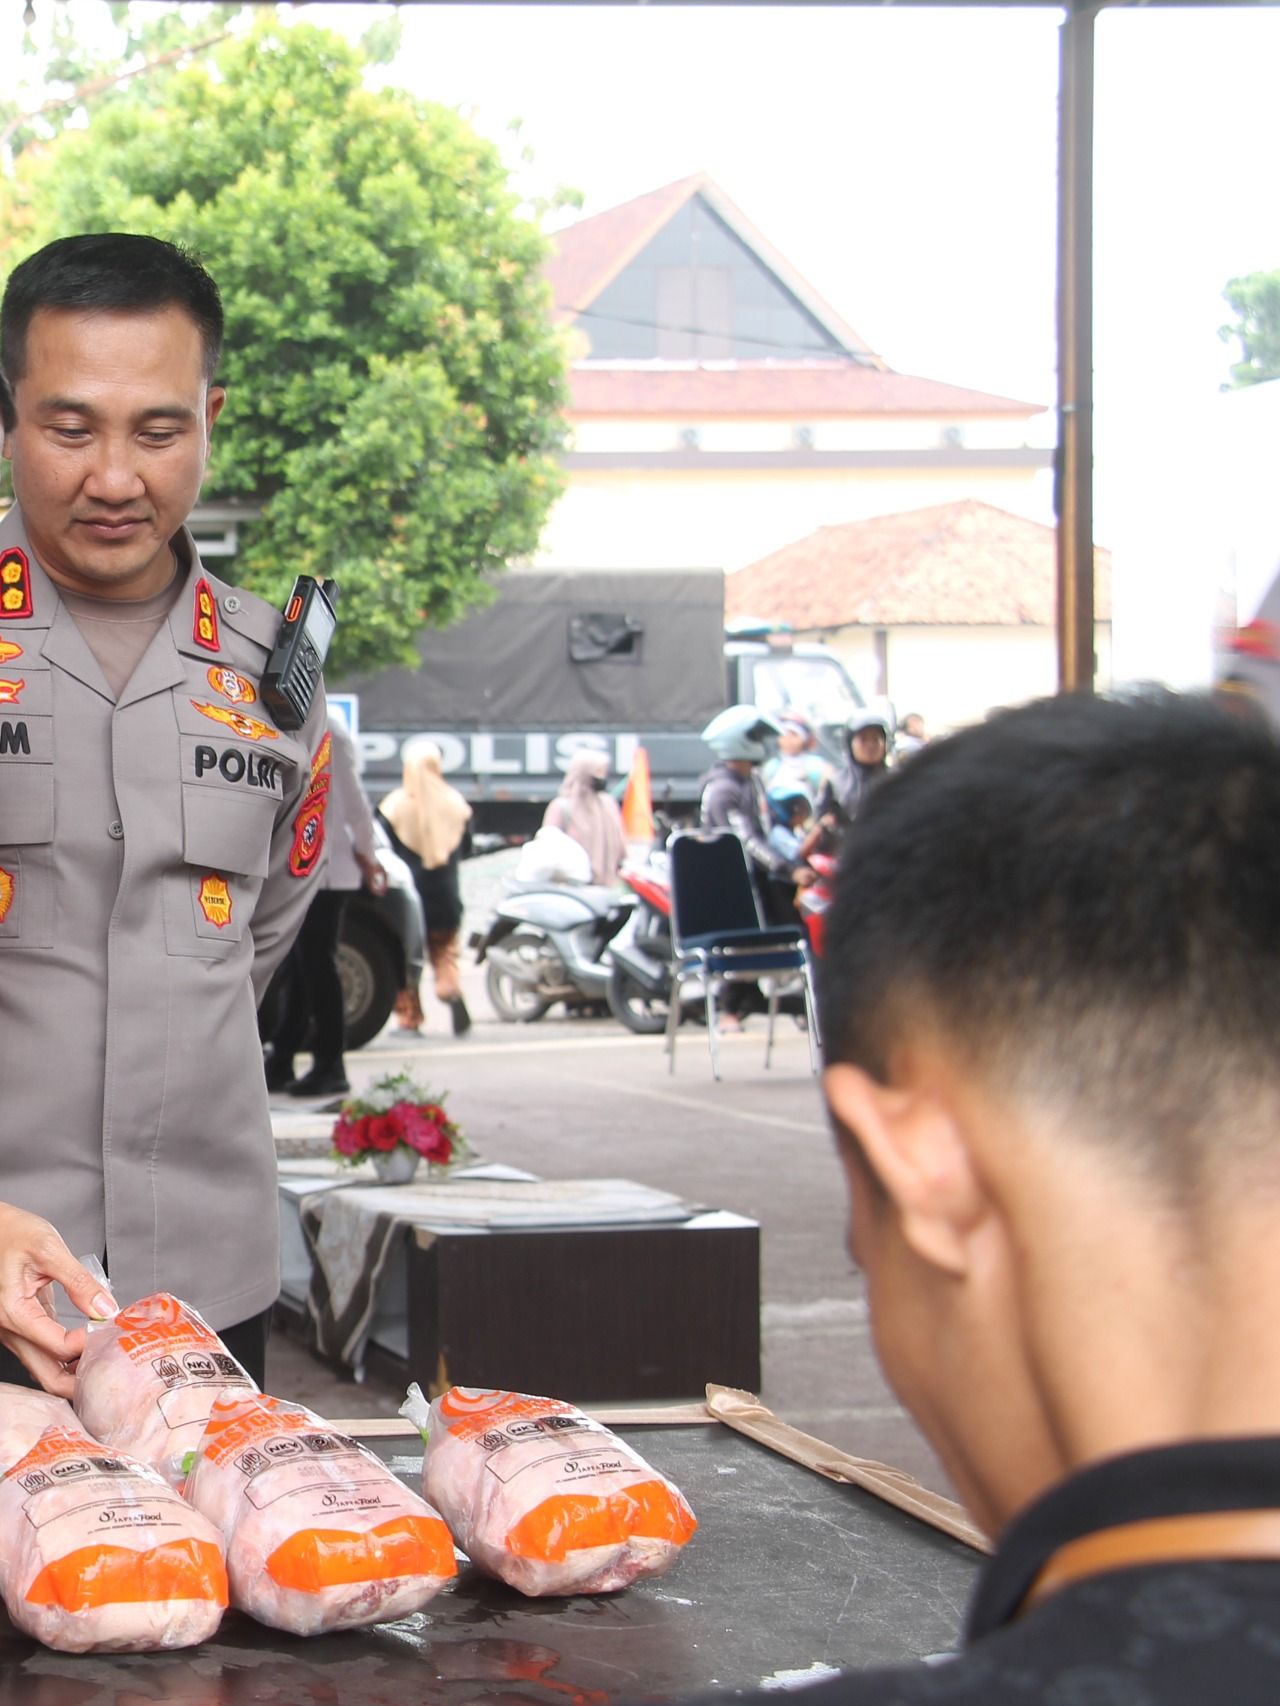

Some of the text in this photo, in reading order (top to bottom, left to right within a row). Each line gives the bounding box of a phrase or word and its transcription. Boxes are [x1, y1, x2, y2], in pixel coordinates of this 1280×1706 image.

[357, 731, 641, 775] POLISI
[195, 745, 280, 790] POLRI
[187, 1361, 211, 1370] NKV
[511, 1424, 539, 1434] NKV
[269, 1441, 299, 1453] NKV
[55, 1463, 86, 1475] NKV
